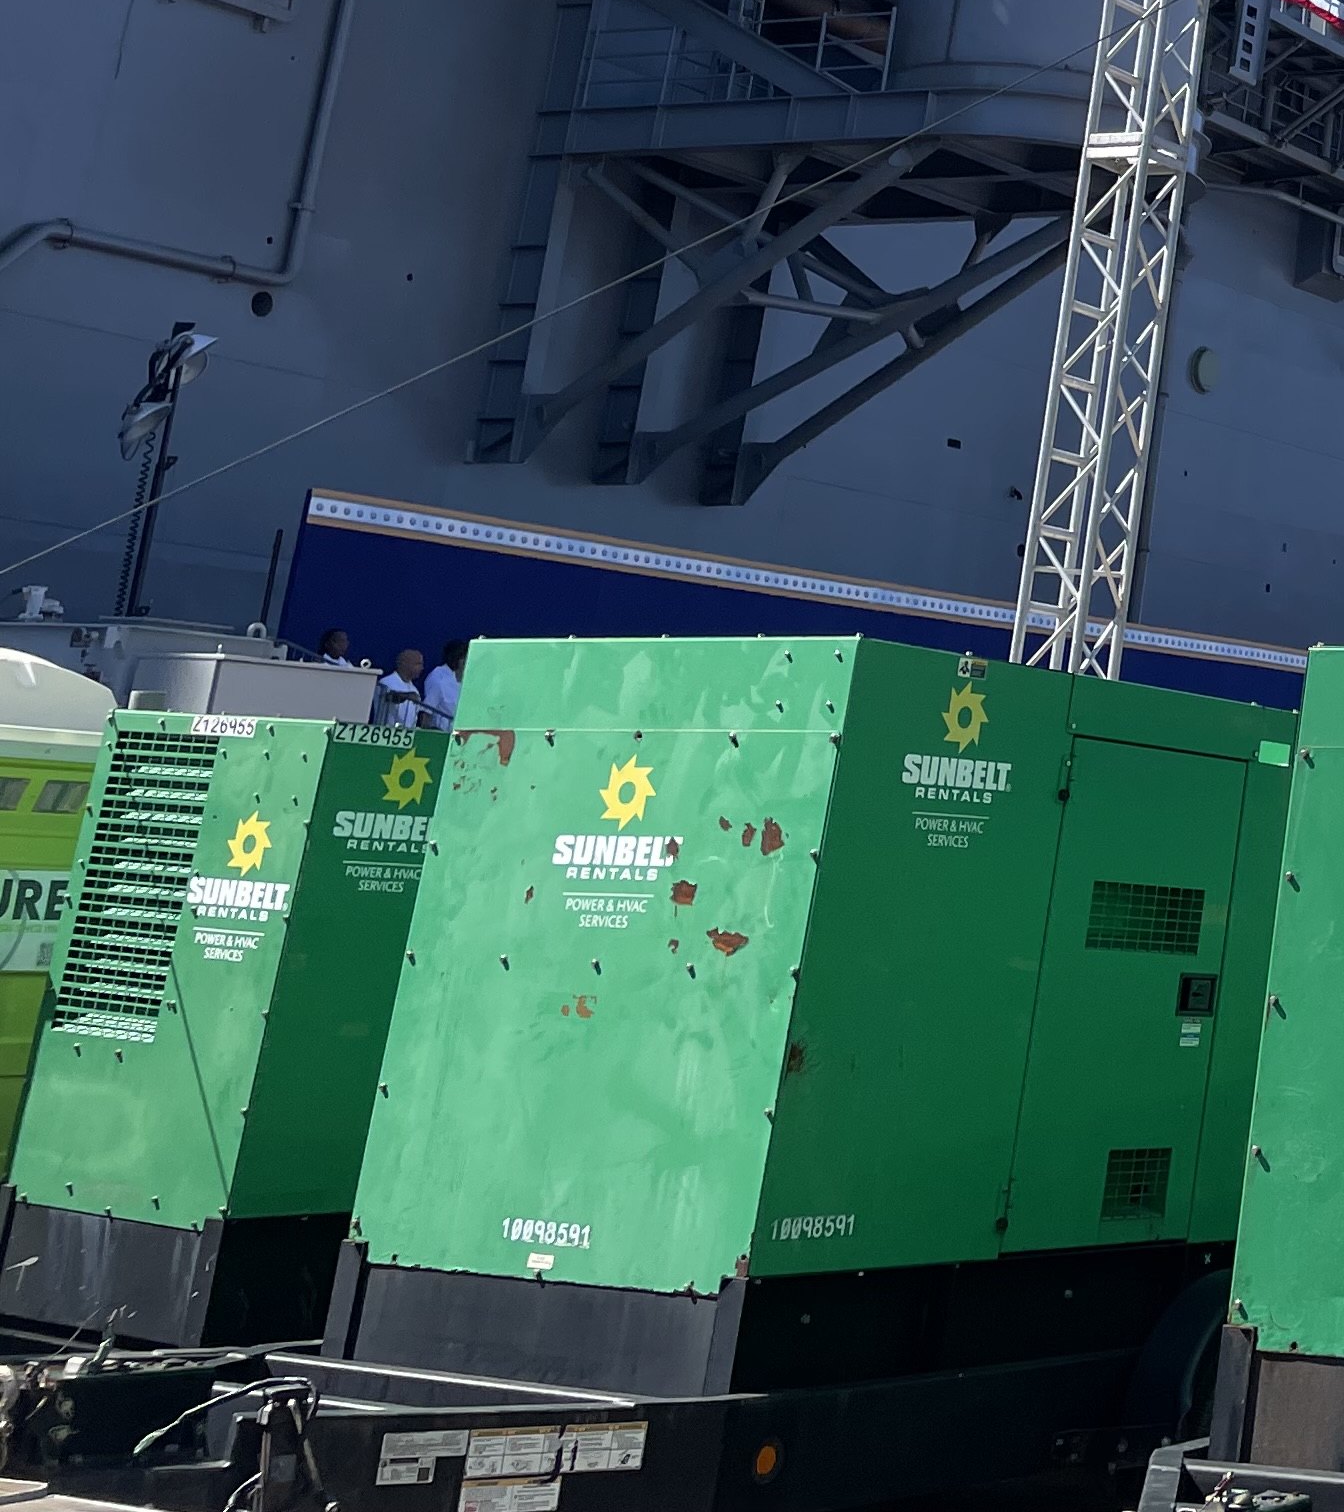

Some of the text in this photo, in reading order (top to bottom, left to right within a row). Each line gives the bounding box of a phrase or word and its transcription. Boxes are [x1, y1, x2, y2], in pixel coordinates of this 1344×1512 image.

[333, 723, 414, 747] Z126955
[902, 753, 1012, 792] SUNBELT
[914, 786, 993, 804] RENTALS
[914, 817, 985, 834] POWER & HVAC
[927, 834, 969, 849] SERVICES
[552, 835, 684, 867] SUNBELT
[345, 866, 382, 878] POWER
[383, 869, 392, 880] &
[566, 866, 659, 881] RENTALS
[186, 876, 291, 912] SUNBELT
[358, 880, 404, 893] SERVICES
[195, 905, 269, 922] RENTALS
[565, 898, 648, 913] POWER & HVAC
[578, 914, 629, 928] SERVICES
[193, 932, 259, 949] POWER & HVAC
[203, 946, 243, 962] SERVICES
[502, 1217, 591, 1249] 10098591
[770, 1215, 856, 1240] 10098591
